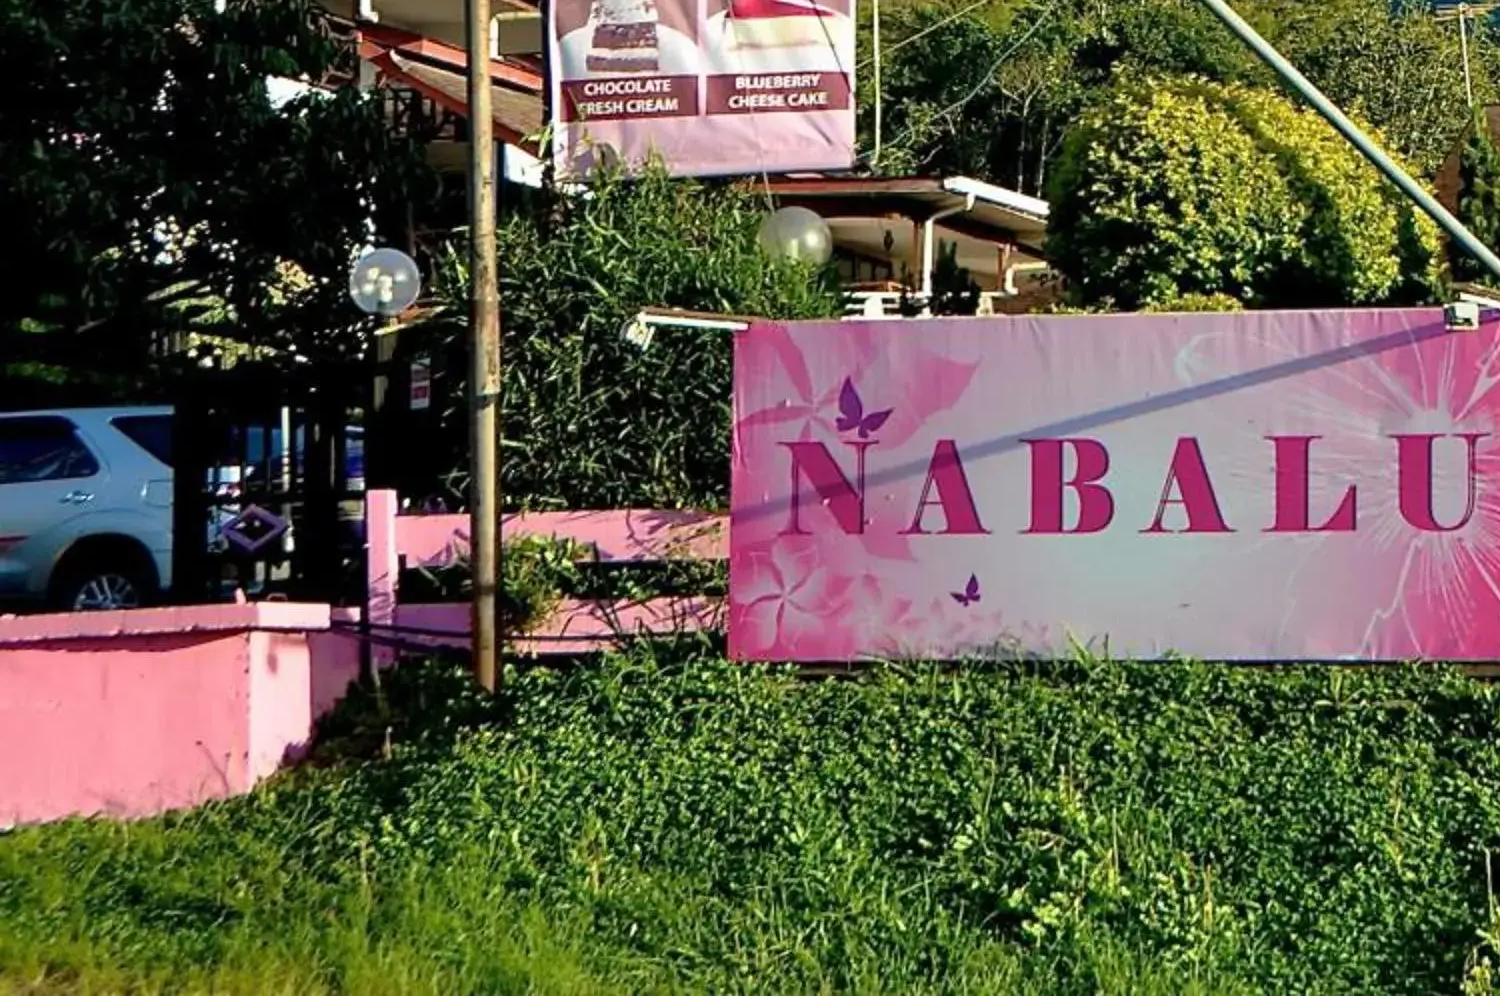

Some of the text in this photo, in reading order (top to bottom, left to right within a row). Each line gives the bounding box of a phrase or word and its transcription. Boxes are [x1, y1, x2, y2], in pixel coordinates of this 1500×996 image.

[584, 79, 672, 96] CHOCOLATE
[735, 74, 821, 90] BLUEBERRY
[579, 98, 679, 115] FRESH CREAM
[728, 91, 828, 108] CHEESE CAKE
[778, 433, 1488, 535] NABALU
